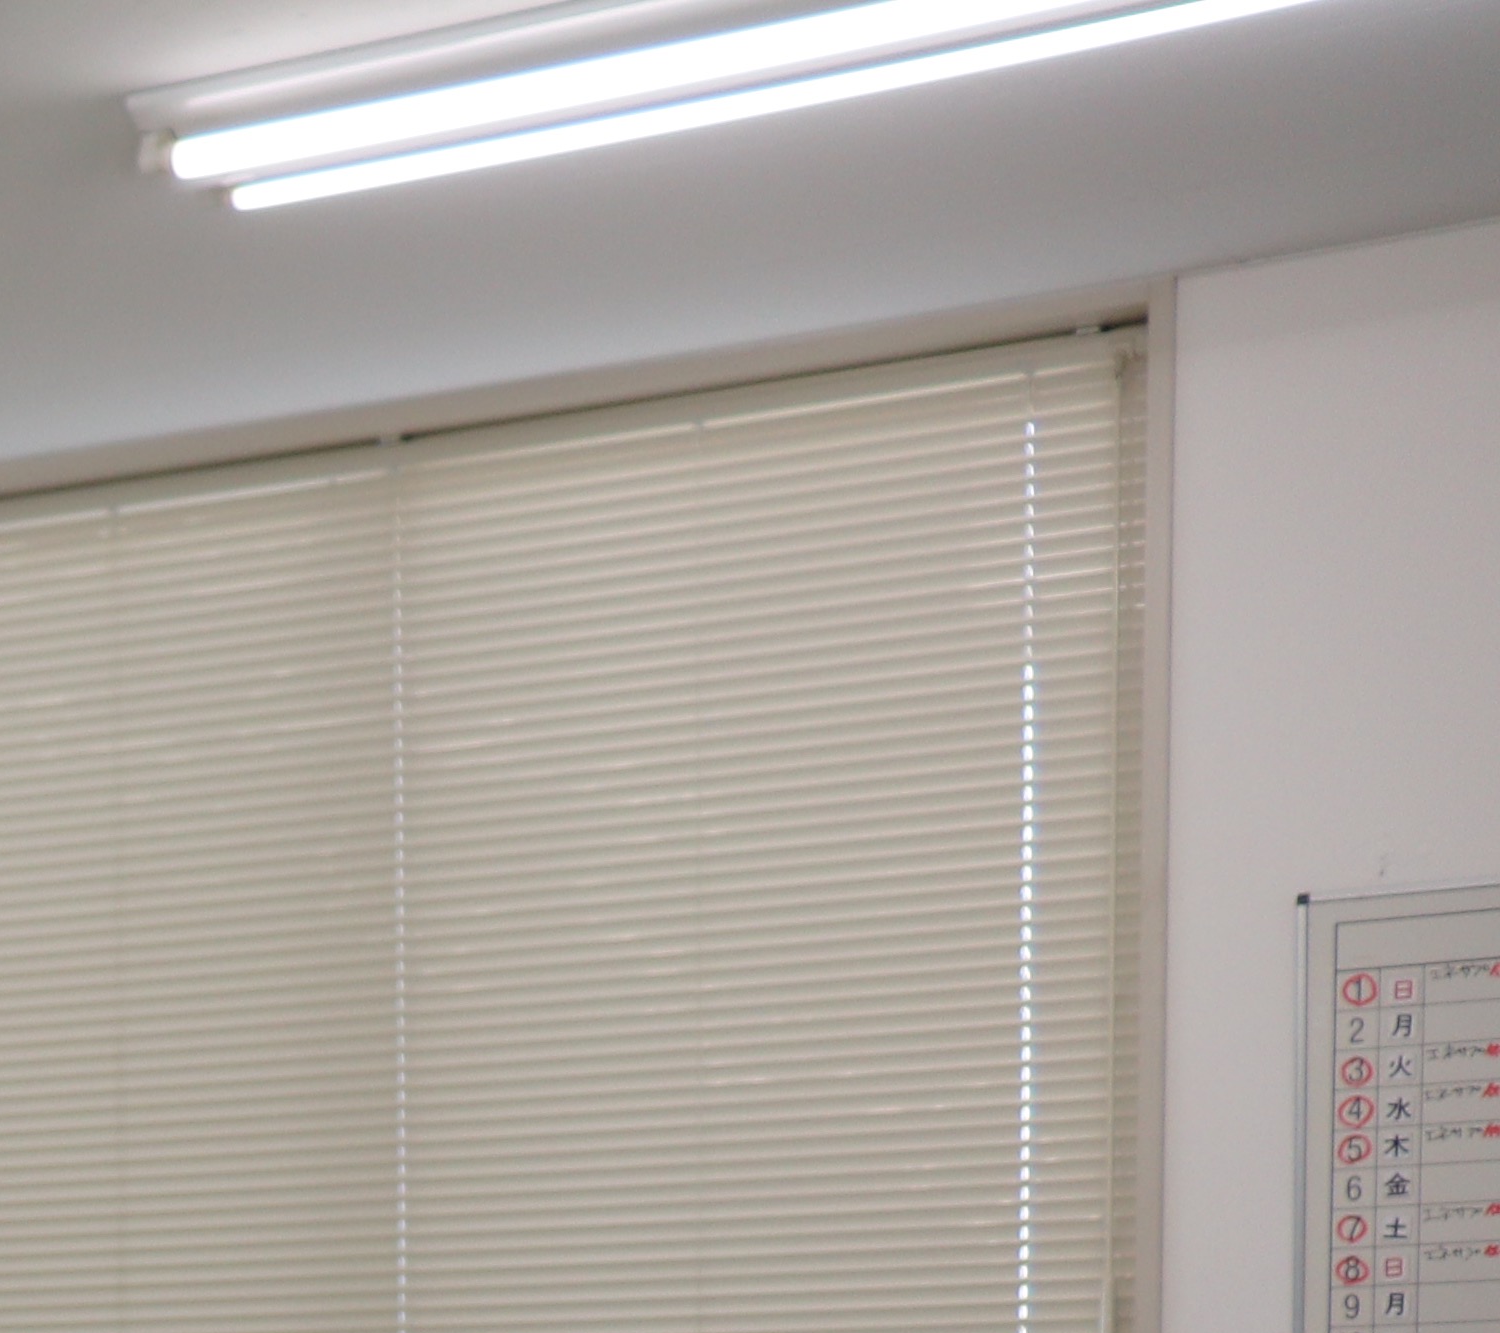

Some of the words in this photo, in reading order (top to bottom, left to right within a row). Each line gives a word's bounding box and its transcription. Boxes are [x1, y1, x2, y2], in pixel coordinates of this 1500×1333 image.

[1355, 978, 1361, 1000] 1
[1394, 980, 1412, 999] 日
[1350, 1018, 1364, 1044] 2
[1393, 1014, 1412, 1037] 月
[1349, 1057, 1364, 1081] 3
[1390, 1056, 1411, 1077] 火
[1348, 1097, 1362, 1120] 4
[1388, 1098, 1410, 1120] 水
[1347, 1136, 1362, 1163] 5
[1385, 1135, 1408, 1156] 木
[1346, 1176, 1361, 1201] 6
[1386, 1173, 1409, 1196] 金
[1347, 1216, 1362, 1242] 7
[1384, 1218, 1406, 1238] 土
[1344, 1256, 1360, 1282] 8
[1385, 1258, 1402, 1277] 日
[1344, 1295, 1359, 1319] 9
[1386, 1293, 1404, 1315] 月
